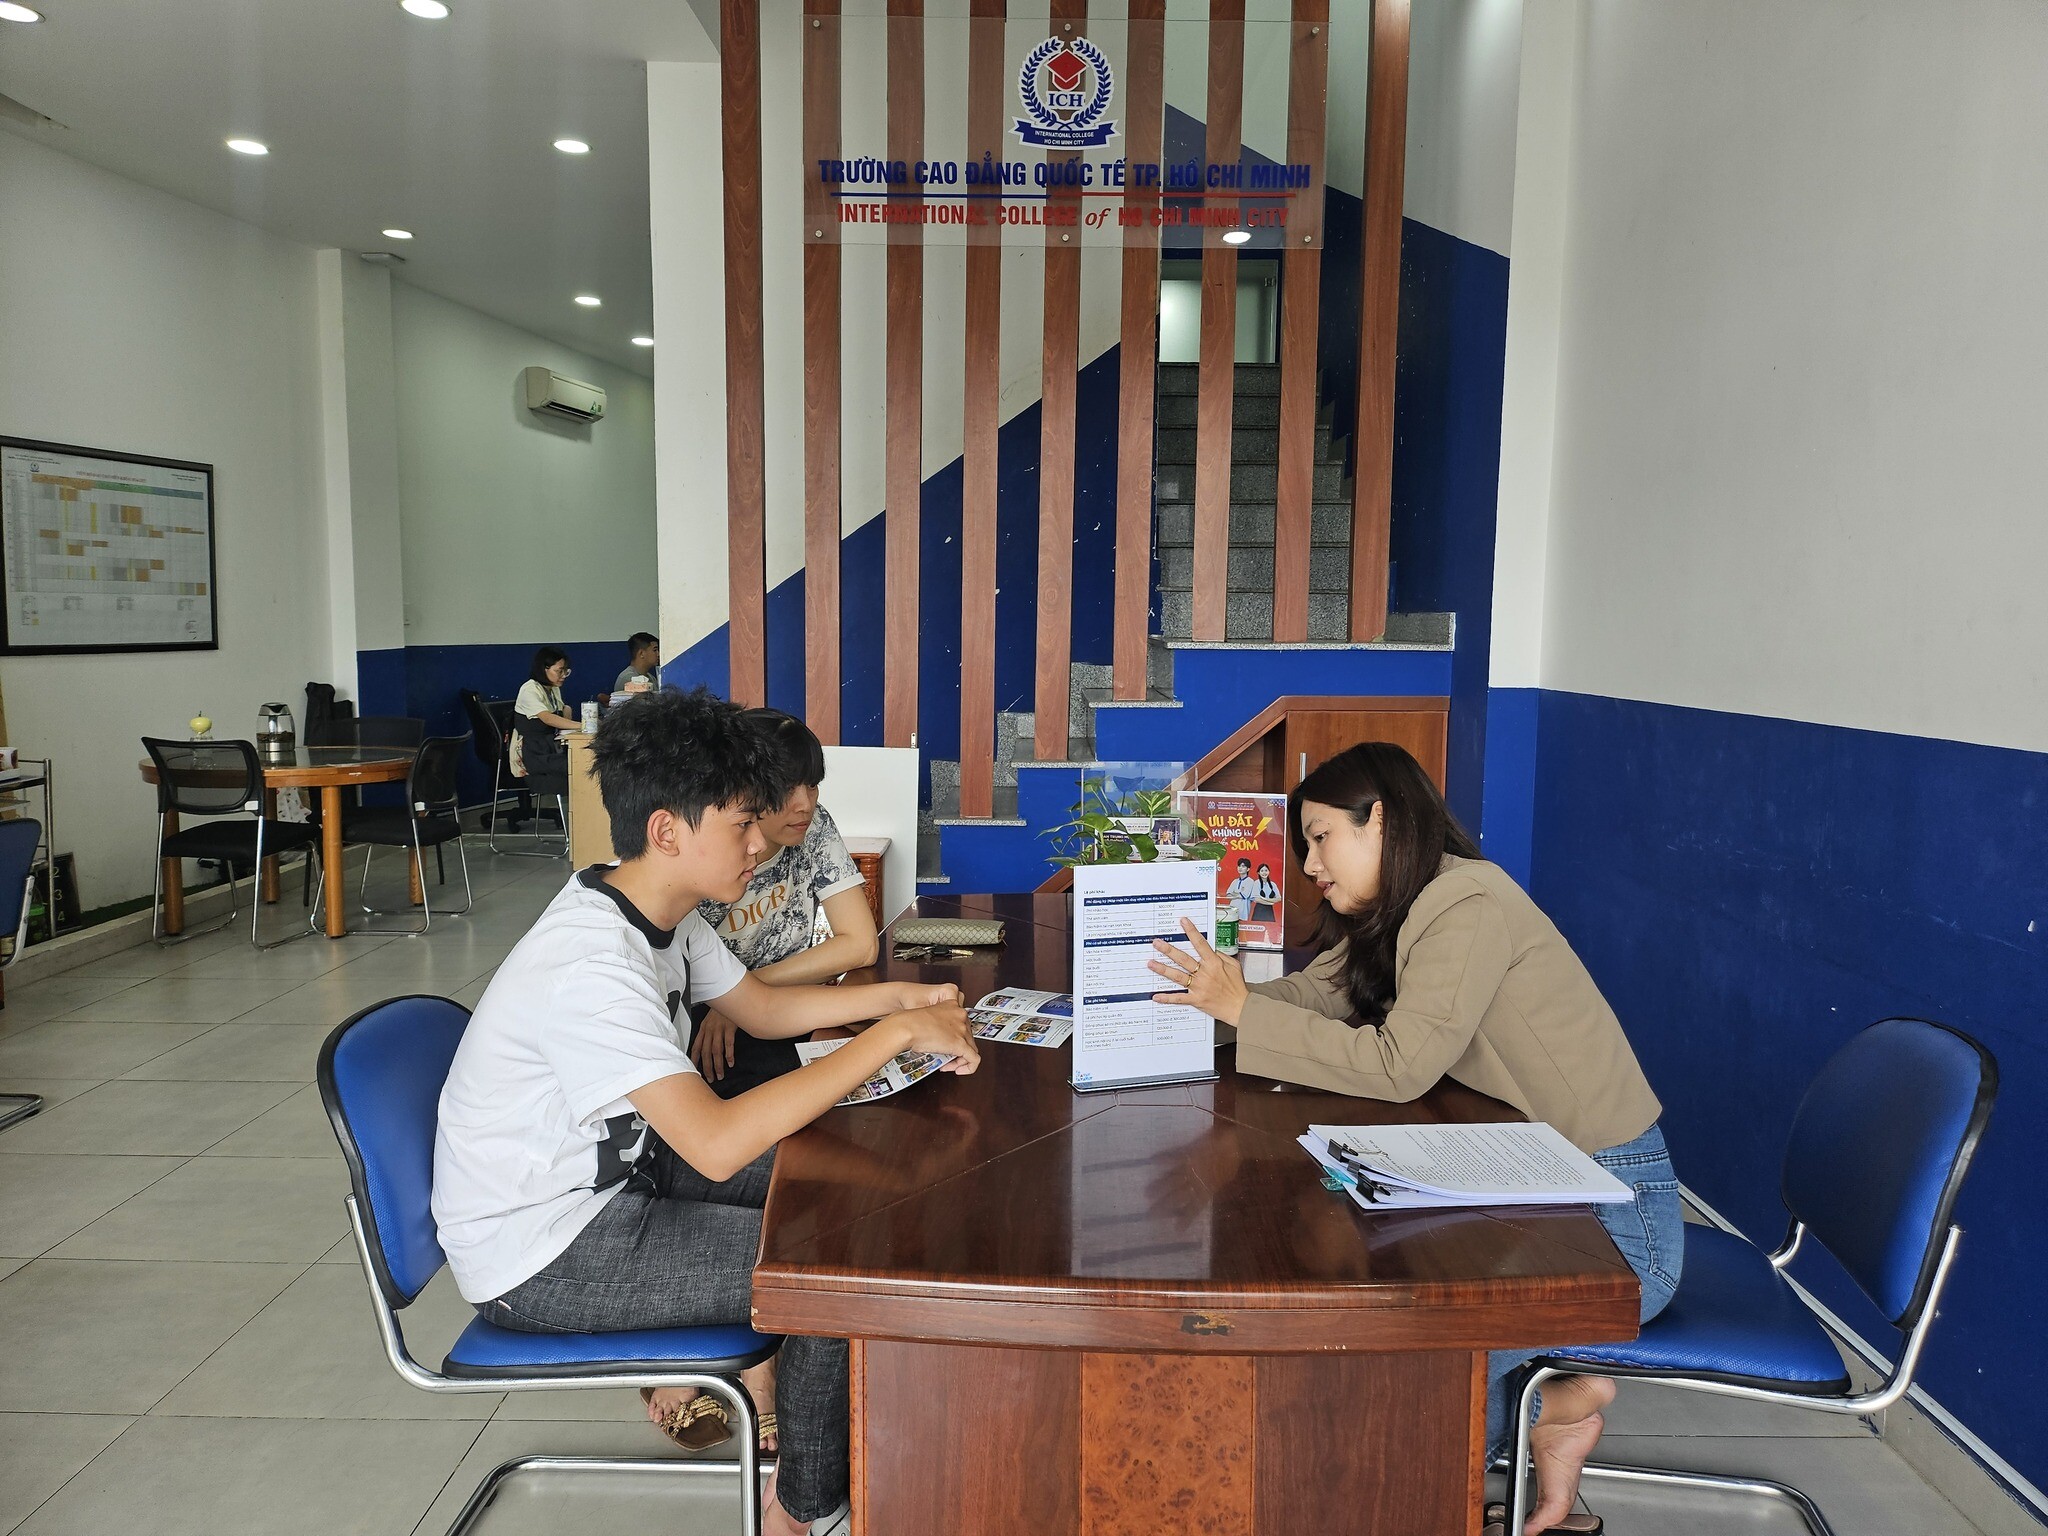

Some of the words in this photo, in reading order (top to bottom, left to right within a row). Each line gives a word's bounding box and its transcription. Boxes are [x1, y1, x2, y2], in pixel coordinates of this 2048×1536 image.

[1049, 93, 1084, 107] ICH
[1034, 130, 1071, 138] INTERNATIONAL
[818, 155, 906, 184] TRƯỜNG
[914, 161, 958, 185] CAO
[965, 150, 1026, 186] ĐẲNG
[1034, 156, 1093, 188] QUỐC
[1100, 157, 1127, 187] TẾ
[1133, 163, 1161, 187] TP.
[1169, 156, 1199, 188] HỒ
[1206, 159, 1242, 188] CHÍ
[1250, 163, 1311, 189] MINH
[837, 203, 988, 225] INTERNATIONAL
[994, 205, 1078, 226] COLLEGE
[1084, 207, 1111, 229] of
[1189, 207, 1241, 227] MINH
[1246, 207, 1290, 227] CITY
[1208, 814, 1224, 827] ƯU
[1227, 812, 1253, 827] ĐÃI
[1211, 827, 1242, 837] KHỦNG
[1230, 837, 1259, 851] SỚM
[53, 866, 60, 878] 2
[54, 888, 63, 900] 3
[57, 910, 65, 921] 4
[728, 884, 787, 933] DIOR
